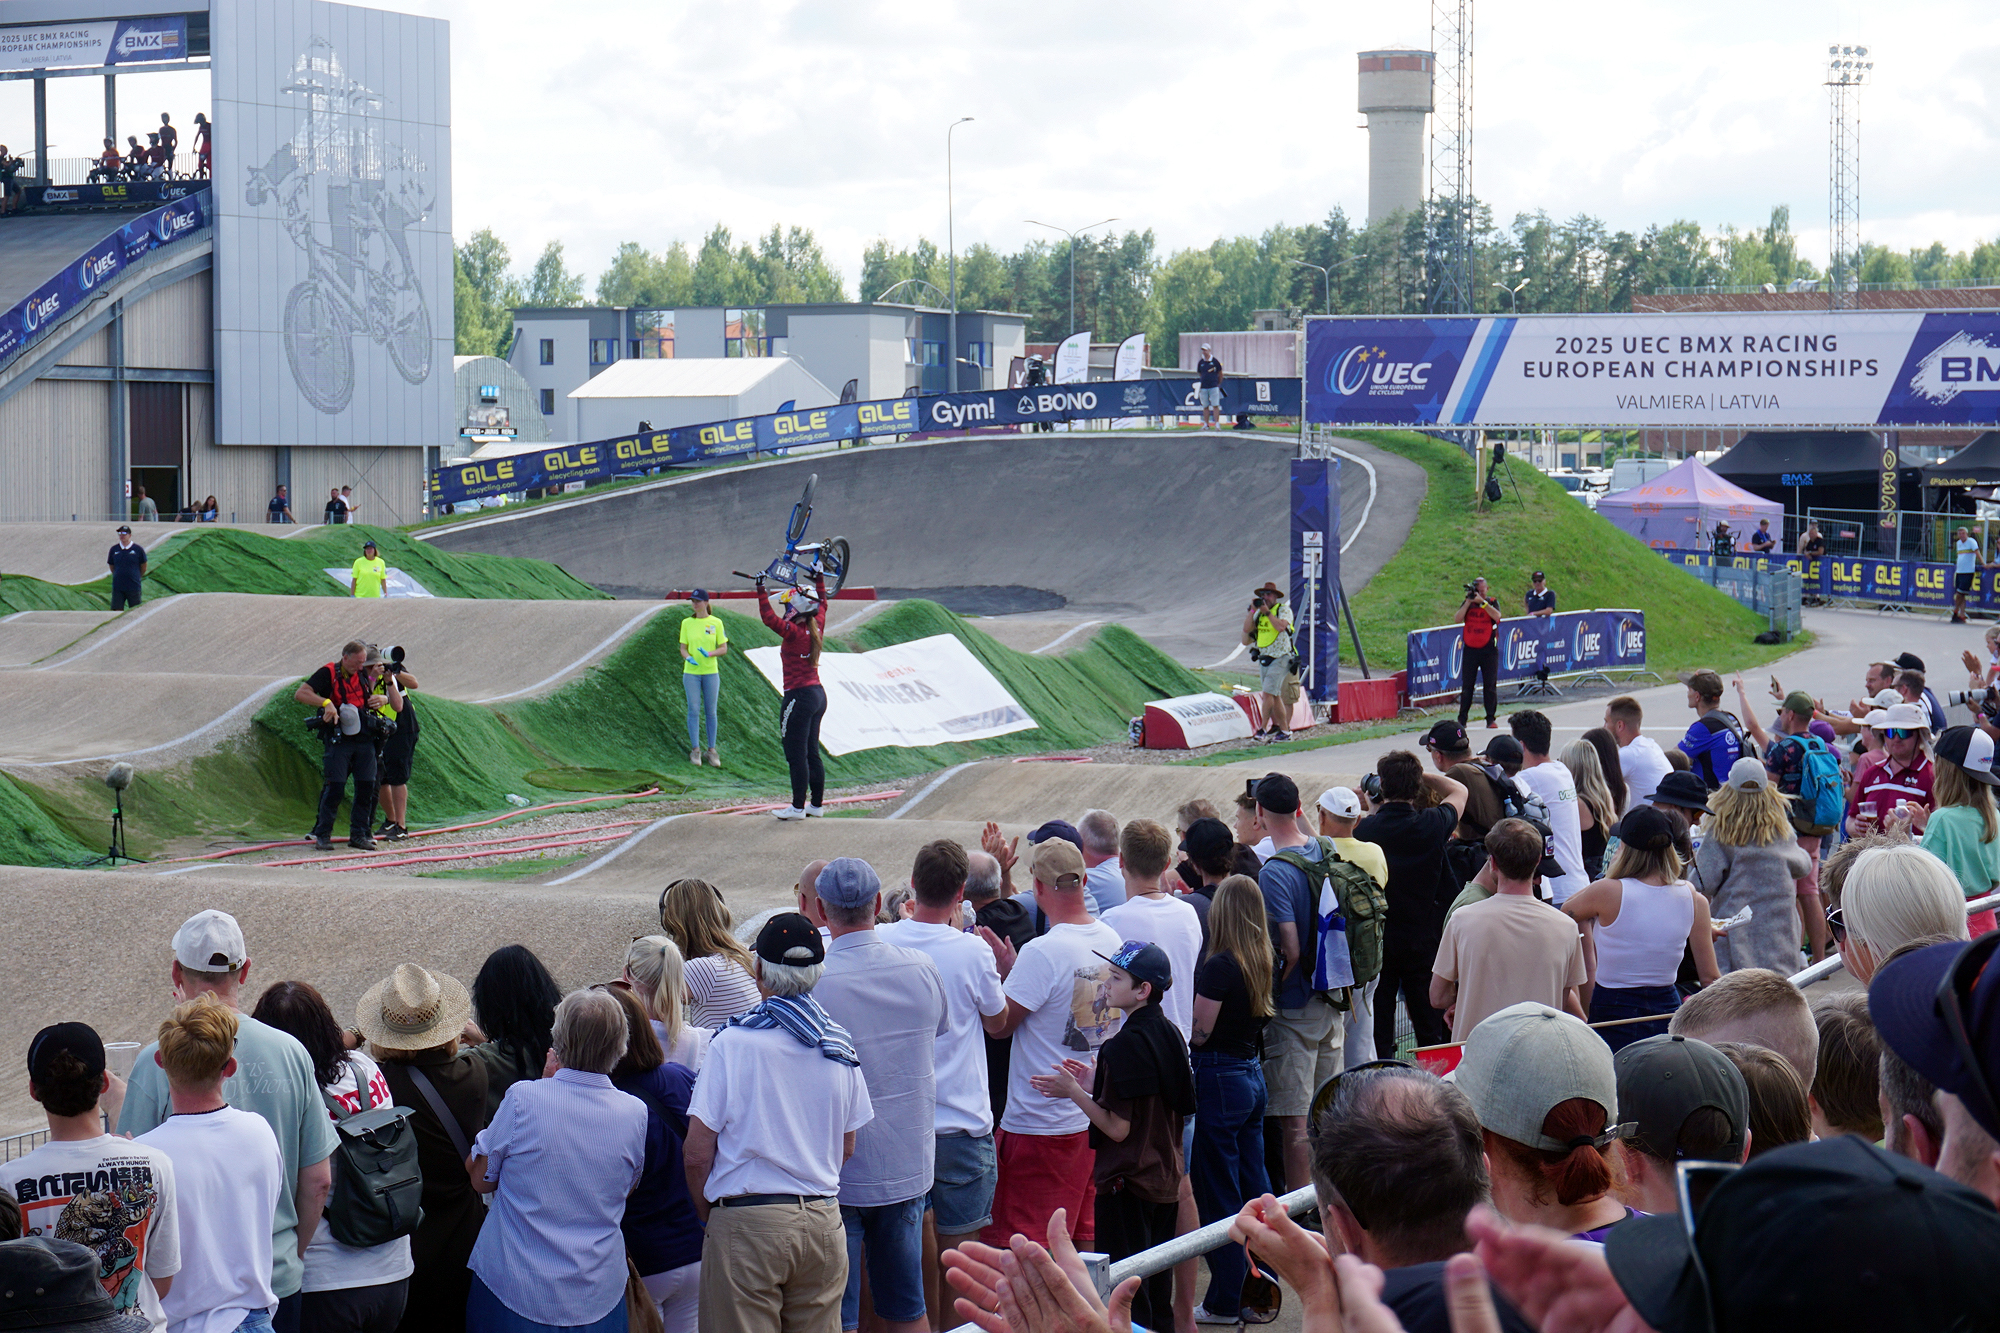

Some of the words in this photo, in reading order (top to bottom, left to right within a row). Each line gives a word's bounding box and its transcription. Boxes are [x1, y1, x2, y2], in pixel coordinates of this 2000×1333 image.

[2, 35, 20, 43] 2025
[23, 33, 38, 41] UEC
[40, 32, 57, 41] BMX
[60, 30, 89, 40] RACING
[125, 35, 160, 48] BMX
[0, 43, 34, 53] ROPEAN
[36, 39, 102, 51] CHAMPIONSHIPS
[21, 56, 50, 64] VALMIERA
[53, 54, 72, 62] LATVIA
[170, 187, 186, 196] UEC
[173, 211, 195, 229] UEC
[93, 251, 116, 273] UEC
[37, 292, 60, 317] UEC
[1555, 337, 1613, 354] 2025
[1623, 336, 1670, 354] UEC
[1680, 336, 1733, 353] BMX
[1743, 335, 1837, 353] RACING
[1372, 362, 1432, 384] UEC
[1524, 361, 1654, 378] EUROPEAN
[1665, 359, 1878, 378] CHAMPIONSHIPS
[1941, 356, 2000, 382] BM
[1038, 391, 1097, 413] BONO
[1616, 395, 1706, 409] VALMIERA
[1720, 394, 1780, 409] LATVIA
[932, 397, 995, 427] Gym!
[861, 422, 912, 434] alecycling.com
[778, 431, 829, 444] alecycling.com
[704, 441, 756, 454] alecycling.com
[621, 455, 673, 469] alecycling.com
[549, 466, 600, 480] alecycling.com
[1781, 473, 1813, 482] BMX
[466, 481, 517, 495] alecycling.com
[1584, 632, 1600, 651] UEC
[1627, 631, 1643, 649] UEC
[1517, 639, 1540, 660] UEC
[837, 679, 940, 706] VALMIERA
[1170, 699, 1235, 719] VALMIERAS
[97, 1161, 125, 1169] ALWAYS
